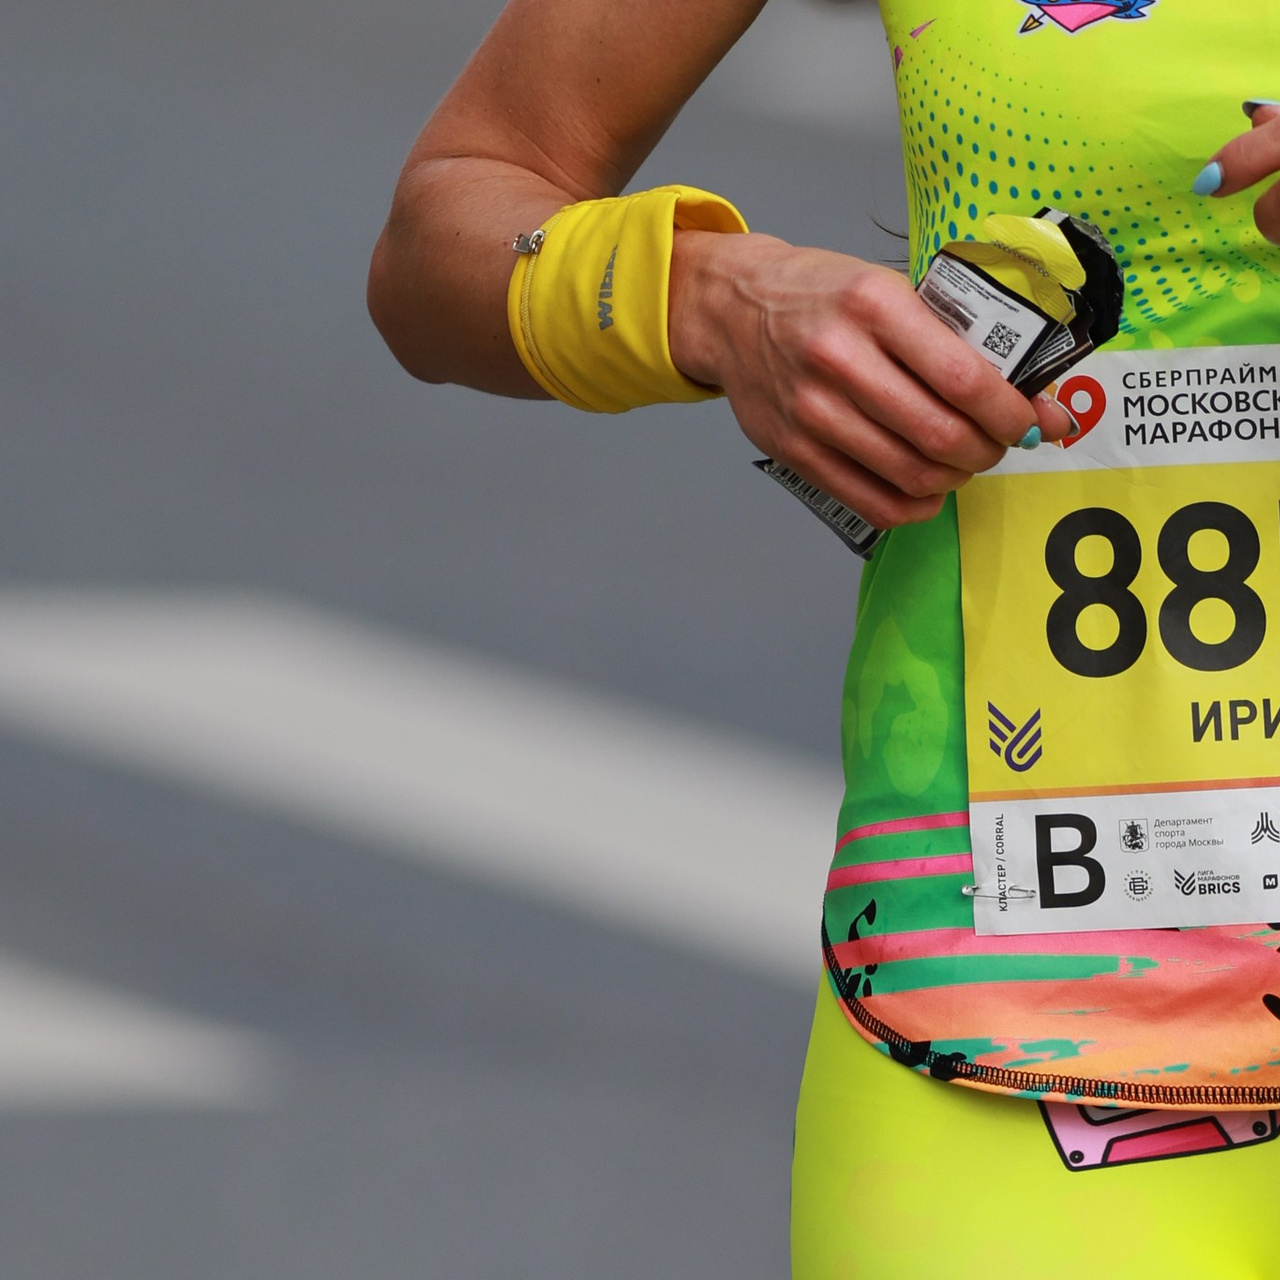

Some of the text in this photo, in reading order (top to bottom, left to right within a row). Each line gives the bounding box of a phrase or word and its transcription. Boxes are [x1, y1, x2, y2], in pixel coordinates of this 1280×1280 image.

[1122, 363, 1277, 389] СБЕРПРАЙМ
[1125, 417, 1280, 446] МАРАФОН
[1153, 817, 1214, 828] Департамент
[995, 813, 1005, 855] CORRAL
[1154, 830, 1186, 839] спорта
[1155, 838, 1224, 850] города Москвы
[997, 864, 1008, 912] КЛАСТЕР
[1198, 881, 1241, 896] BRICS
